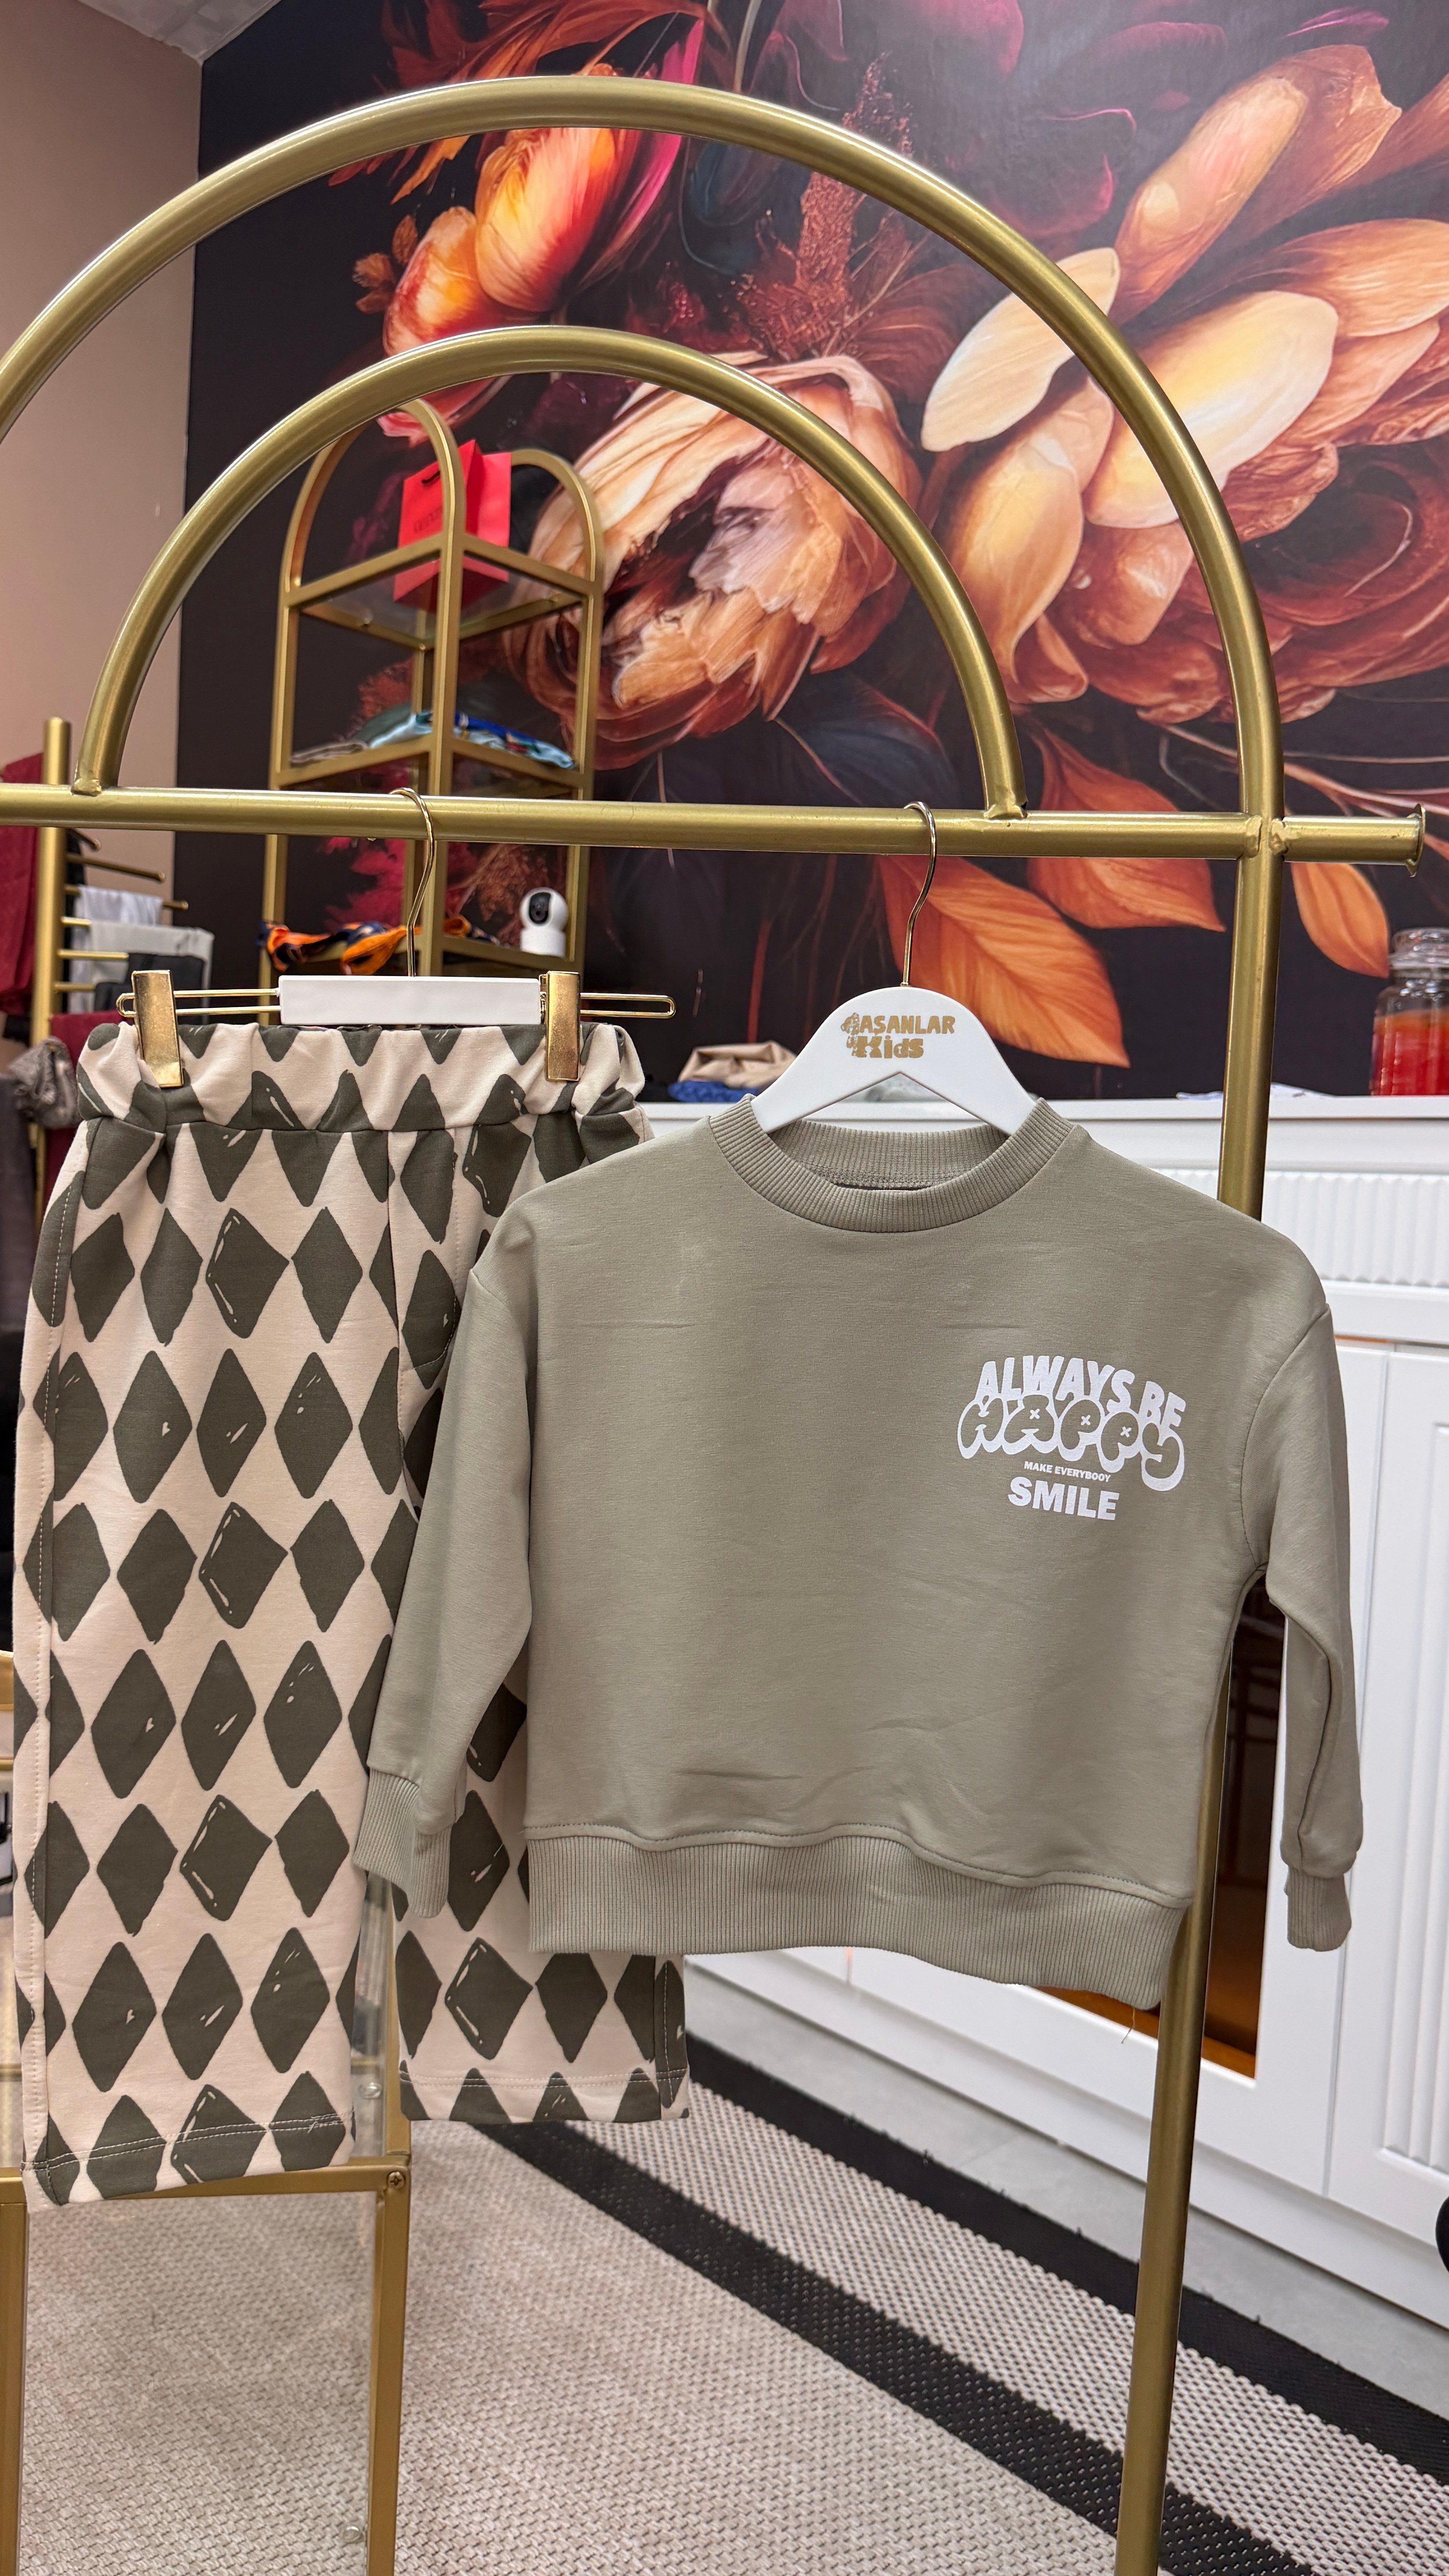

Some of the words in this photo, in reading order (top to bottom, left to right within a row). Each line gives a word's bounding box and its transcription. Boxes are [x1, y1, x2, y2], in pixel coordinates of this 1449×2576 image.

[975, 1355, 1135, 1413] ALWAYS
[1139, 1380, 1186, 1427] BE
[957, 1394, 1185, 1491] HAPPY
[1024, 1461, 1053, 1473] MAKE
[1008, 1477, 1120, 1520] SMILE
